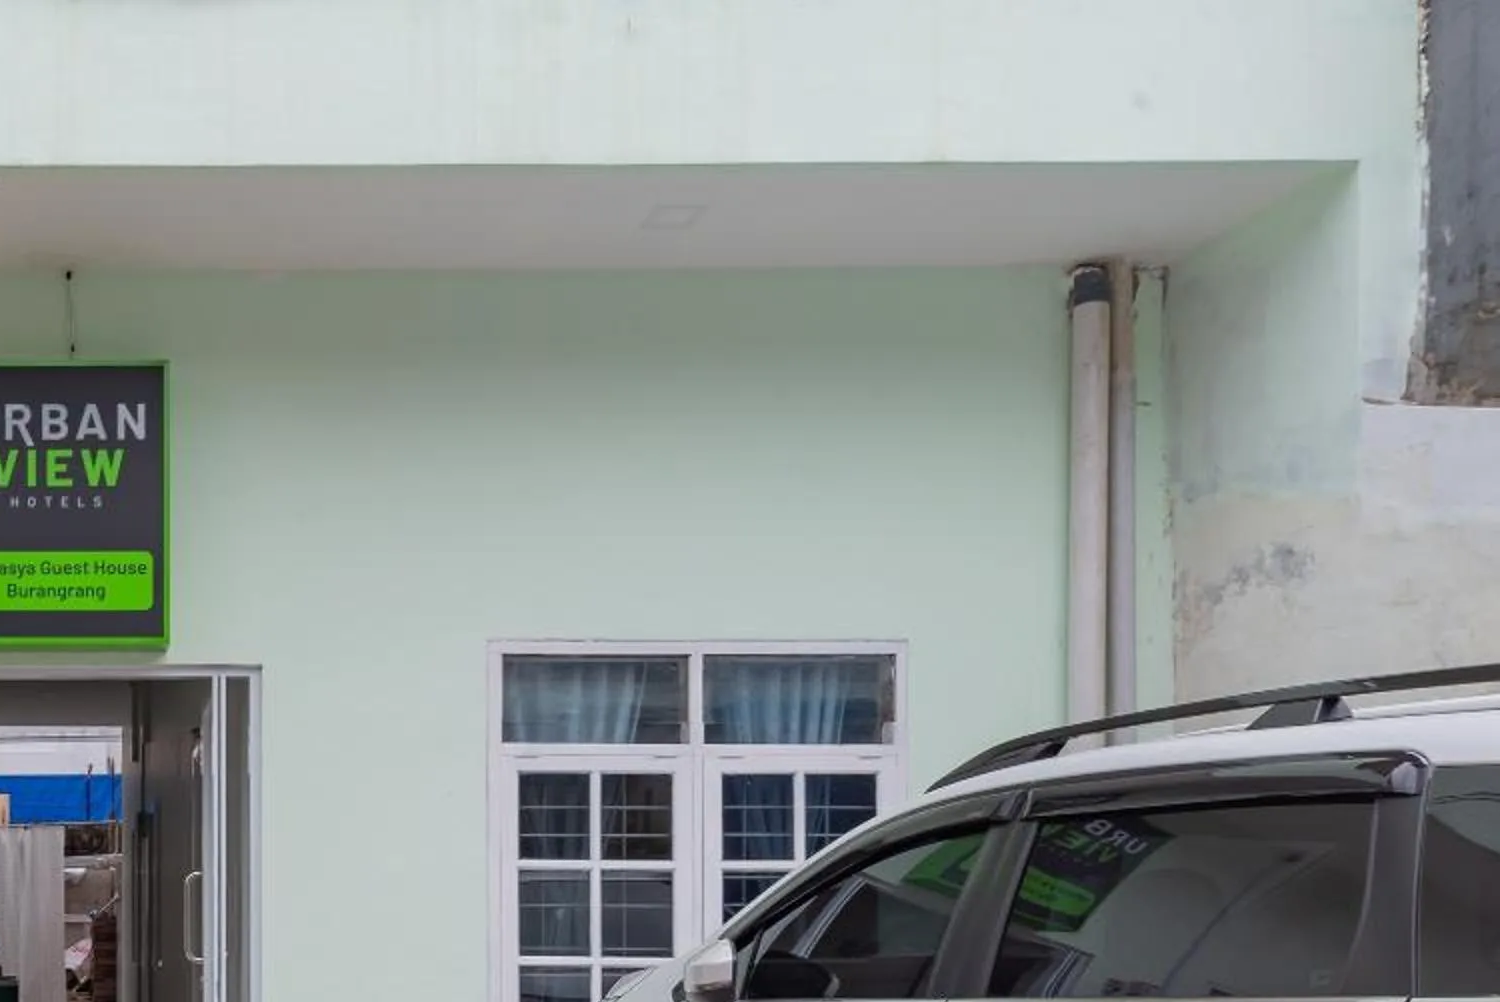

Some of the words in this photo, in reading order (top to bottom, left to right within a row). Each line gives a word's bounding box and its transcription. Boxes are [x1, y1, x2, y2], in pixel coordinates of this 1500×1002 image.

[9, 495, 103, 509] HOTELS
[39, 561, 90, 575] Guest
[93, 560, 148, 575] House
[6, 583, 106, 600] Burangrang
